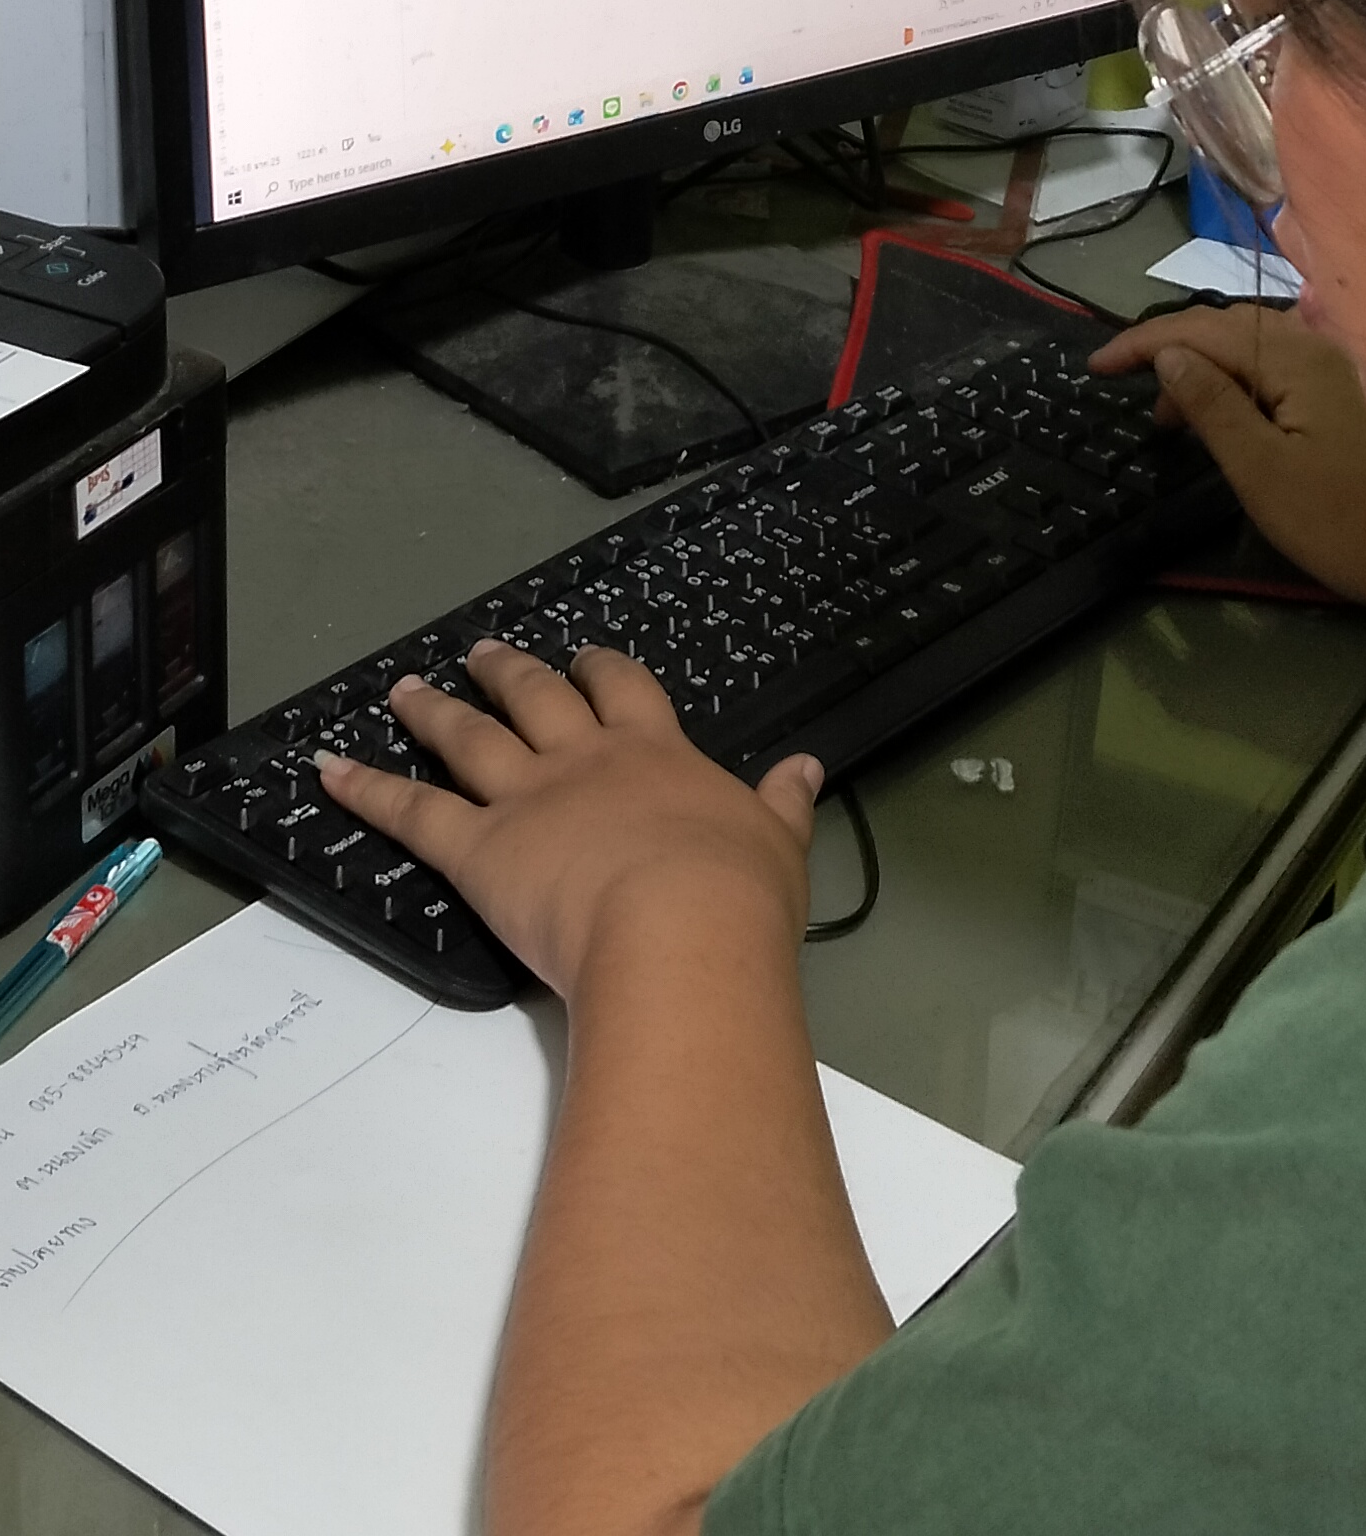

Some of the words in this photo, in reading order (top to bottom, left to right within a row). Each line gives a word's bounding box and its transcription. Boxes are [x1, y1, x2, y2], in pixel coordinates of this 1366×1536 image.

[722, 117, 742, 136] LG
[289, 177, 314, 192] Type
[317, 170, 341, 185] here
[344, 166, 355, 178] to
[359, 158, 392, 175] search
